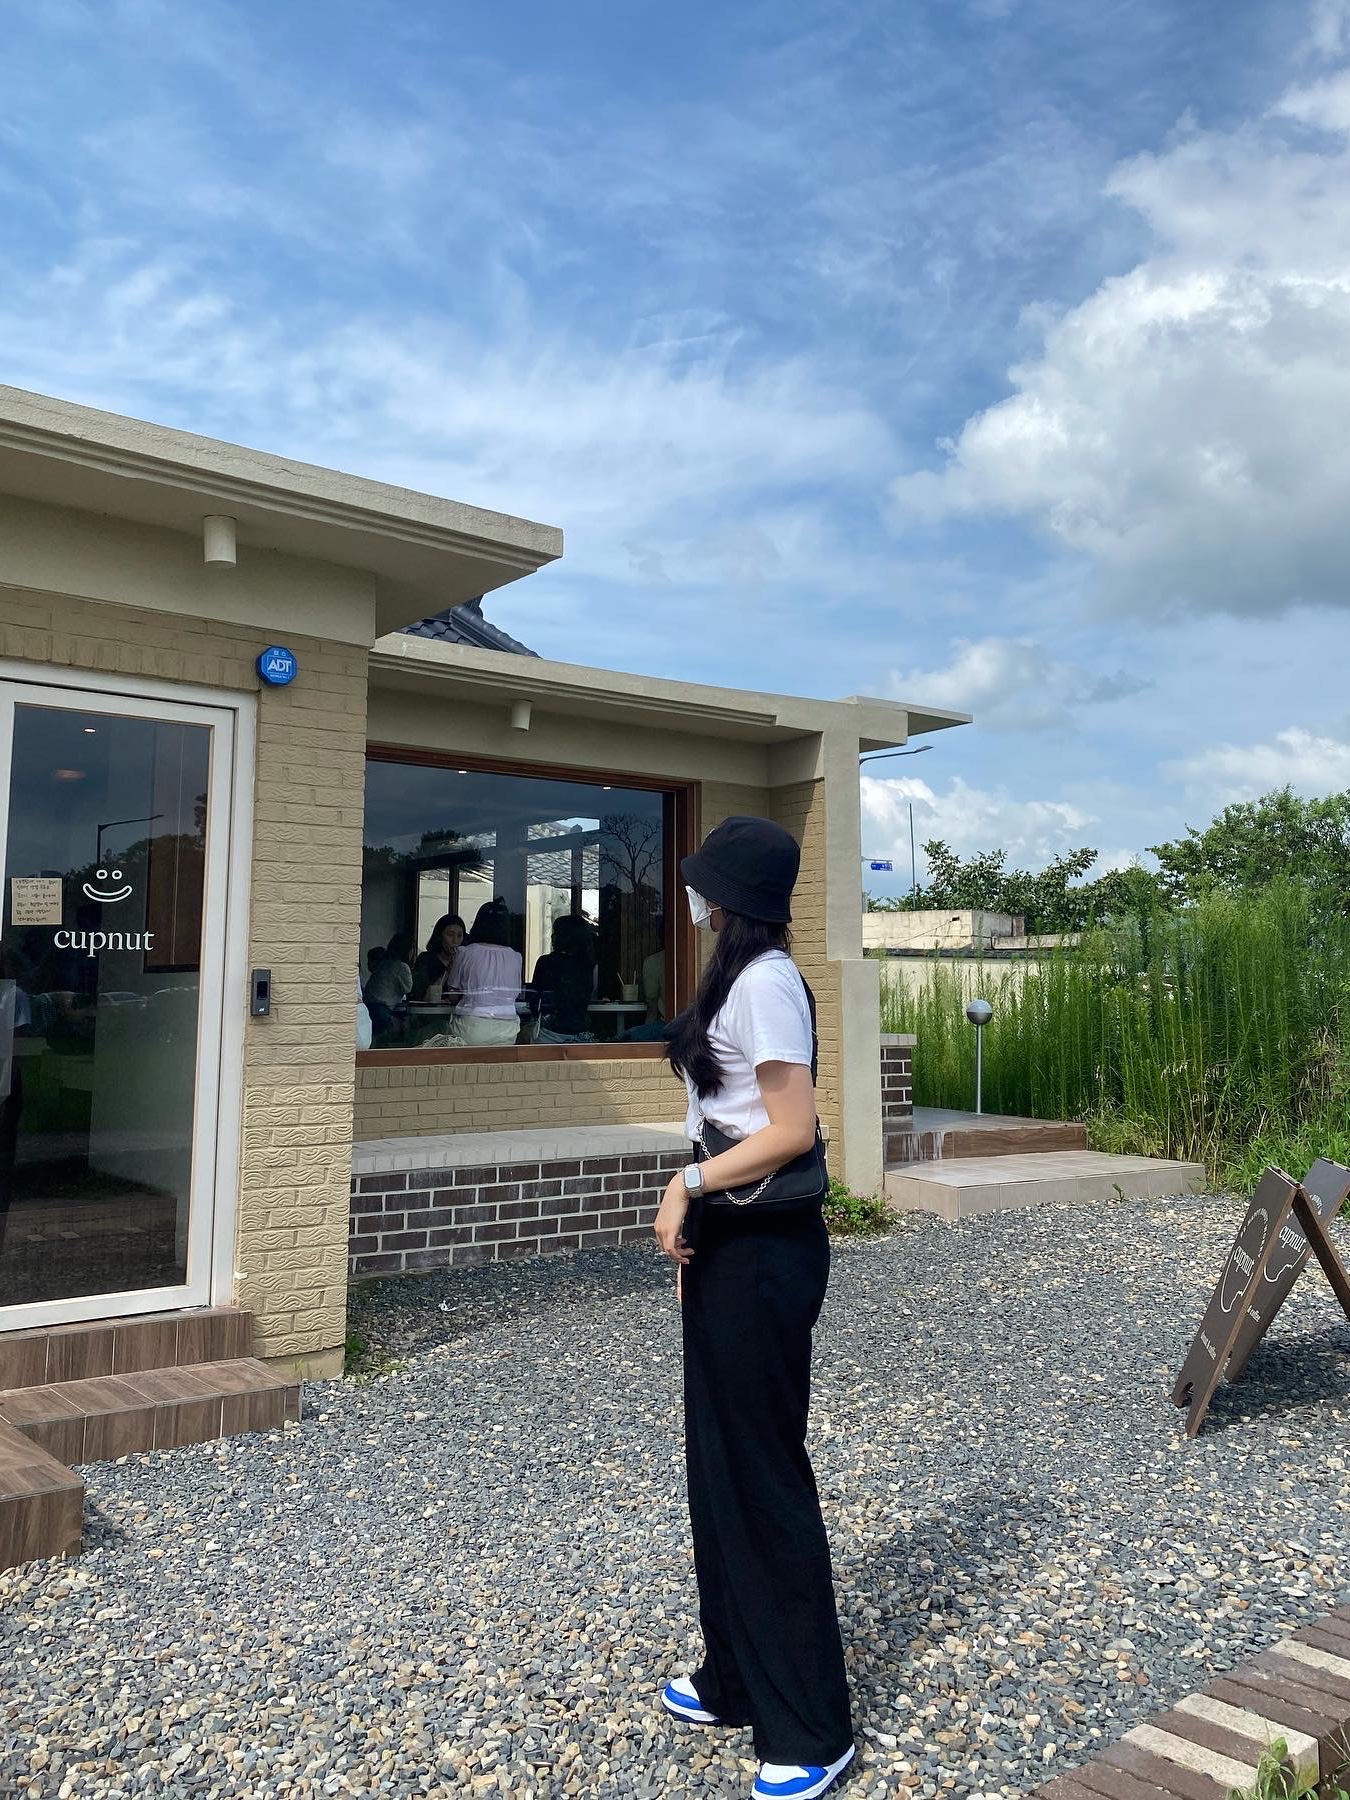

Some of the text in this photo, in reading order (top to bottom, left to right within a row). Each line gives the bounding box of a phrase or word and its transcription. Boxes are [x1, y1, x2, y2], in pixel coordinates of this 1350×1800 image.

[268, 659, 291, 672] ADT
[54, 930, 155, 957] cupnut
[1279, 1226, 1307, 1253] cupnut
[1233, 1245, 1255, 1277] cupnut
